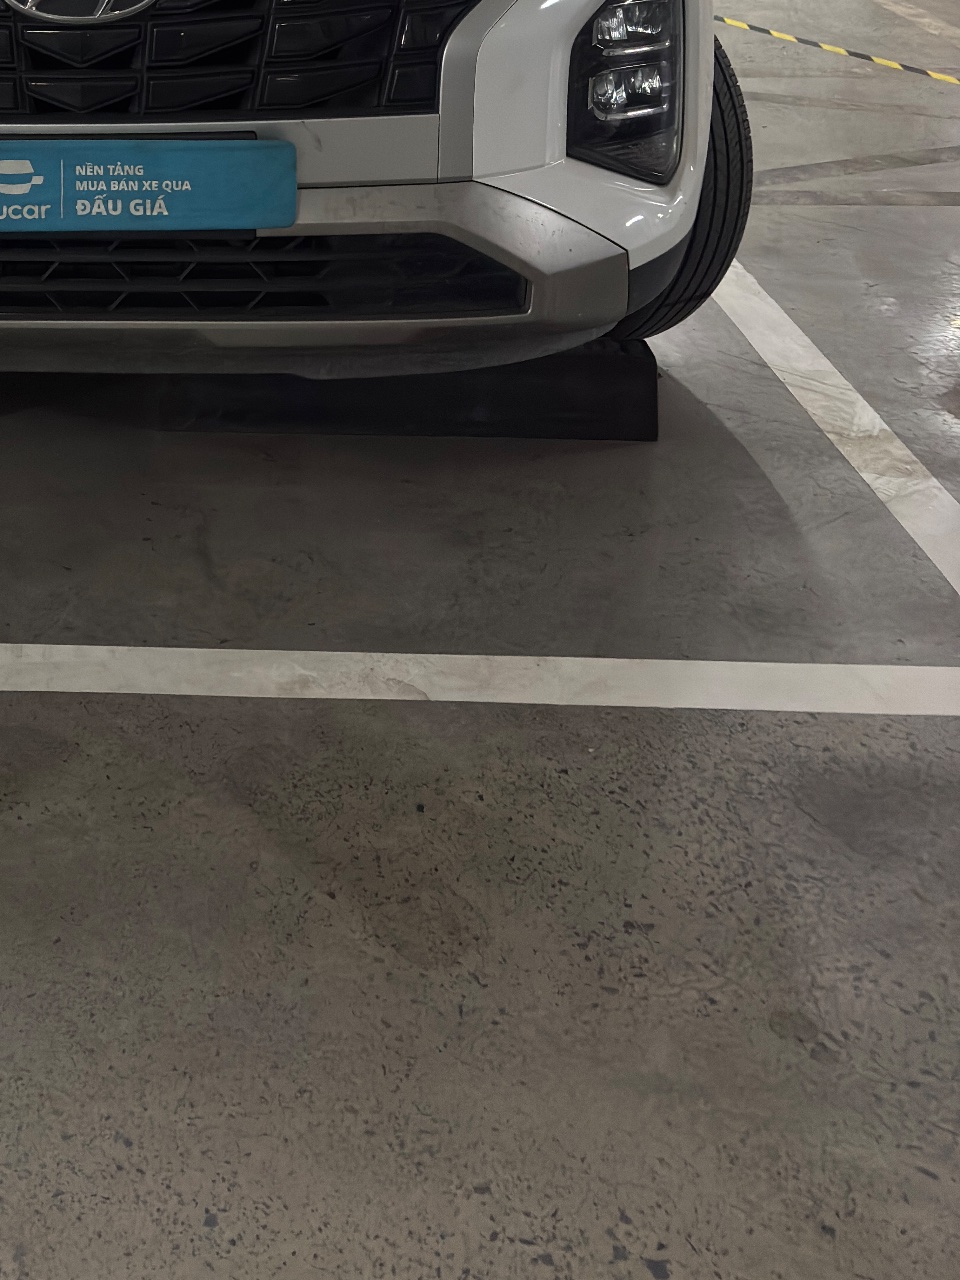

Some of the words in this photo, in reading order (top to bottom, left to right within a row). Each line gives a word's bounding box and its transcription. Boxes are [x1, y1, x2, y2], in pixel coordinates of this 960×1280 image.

[74, 161, 105, 176] NỀN
[107, 161, 145, 176] TẢNG
[74, 180, 108, 192] MUA
[110, 178, 139, 192] BÁN
[142, 180, 159, 192] XE
[161, 180, 192, 193] QUA
[74, 193, 123, 216] ĐẤU
[129, 195, 170, 216] GIÁ
